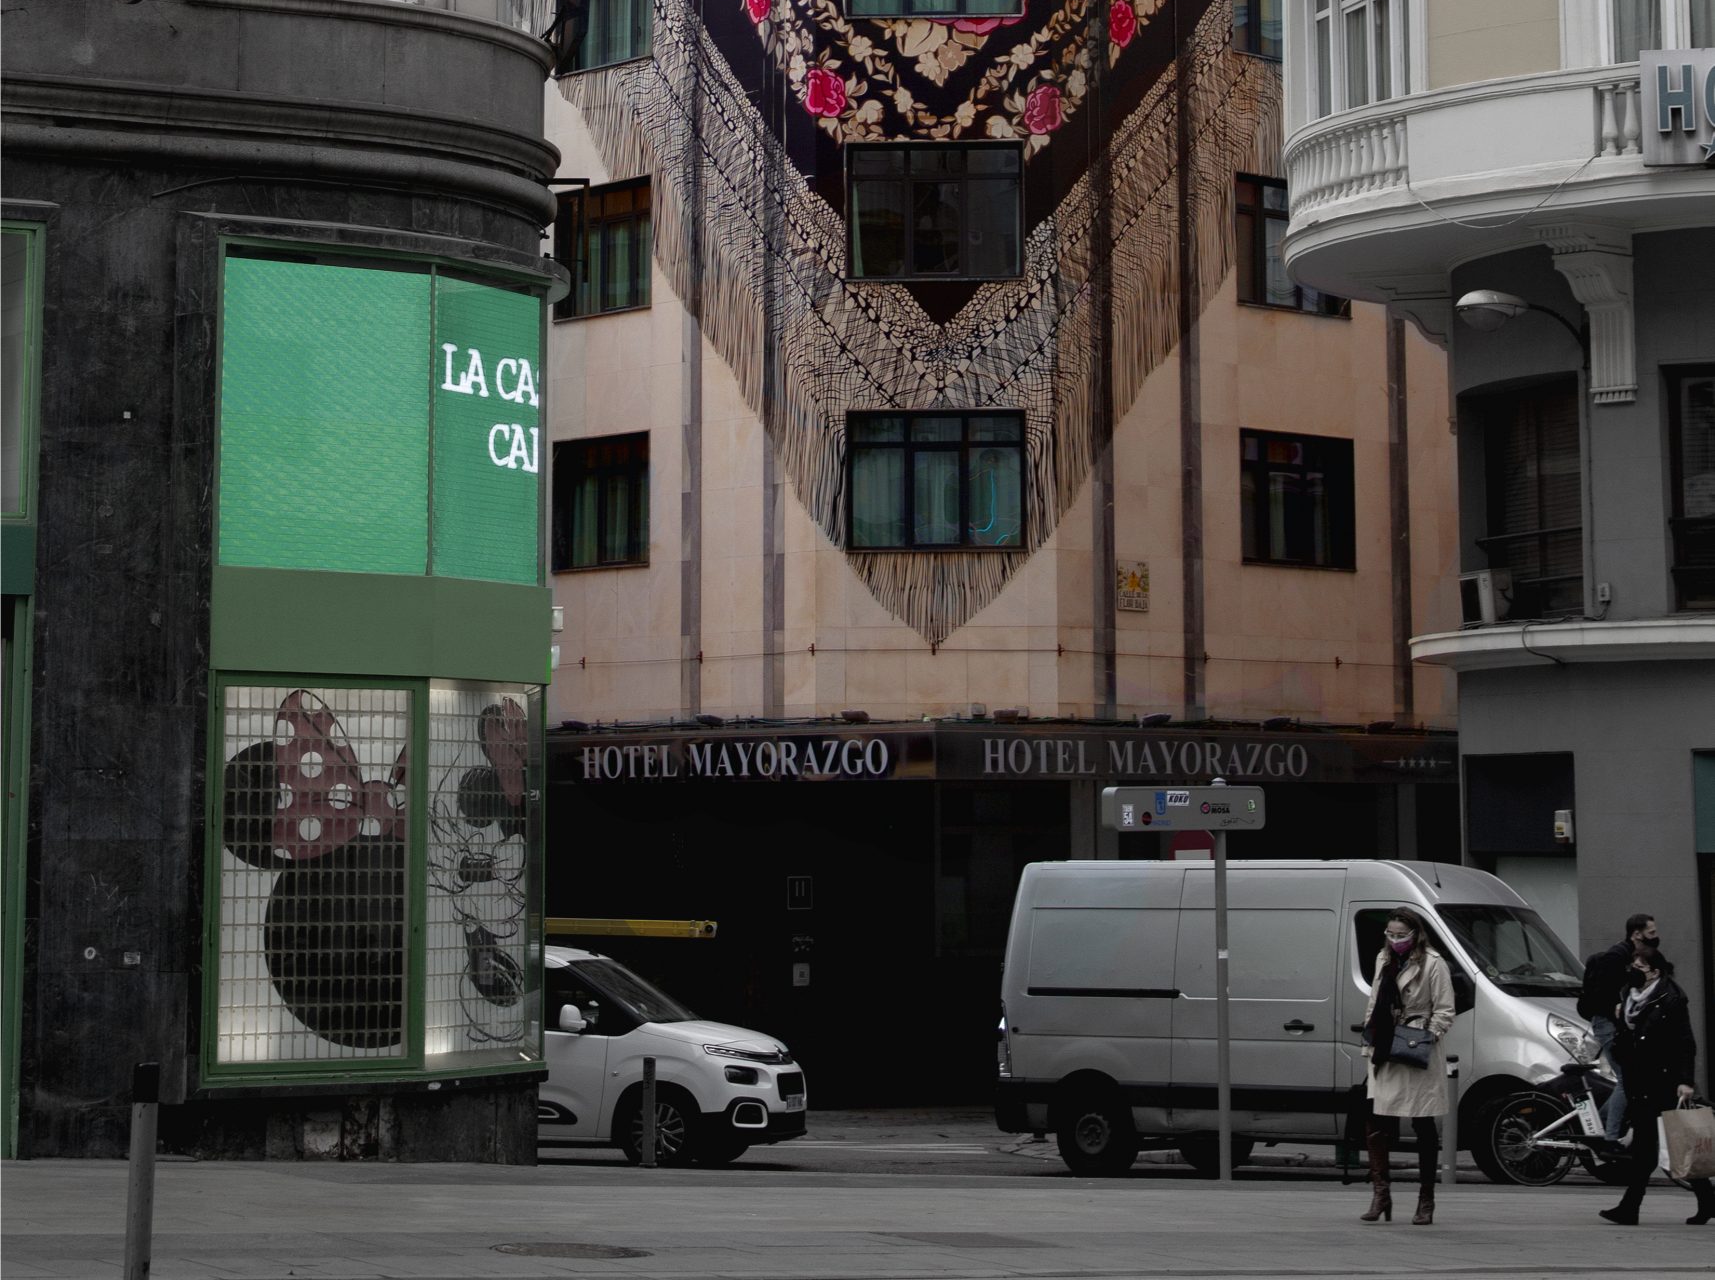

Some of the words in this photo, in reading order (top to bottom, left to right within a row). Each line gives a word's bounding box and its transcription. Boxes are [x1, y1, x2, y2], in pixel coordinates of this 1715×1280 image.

[441, 342, 490, 398] LA
[496, 357, 539, 409] CA
[582, 745, 678, 780] HOTEL
[689, 738, 889, 778] MAYORAZGO
[982, 738, 1096, 775] HOTEL
[1108, 739, 1309, 777] MAYORAZGO
